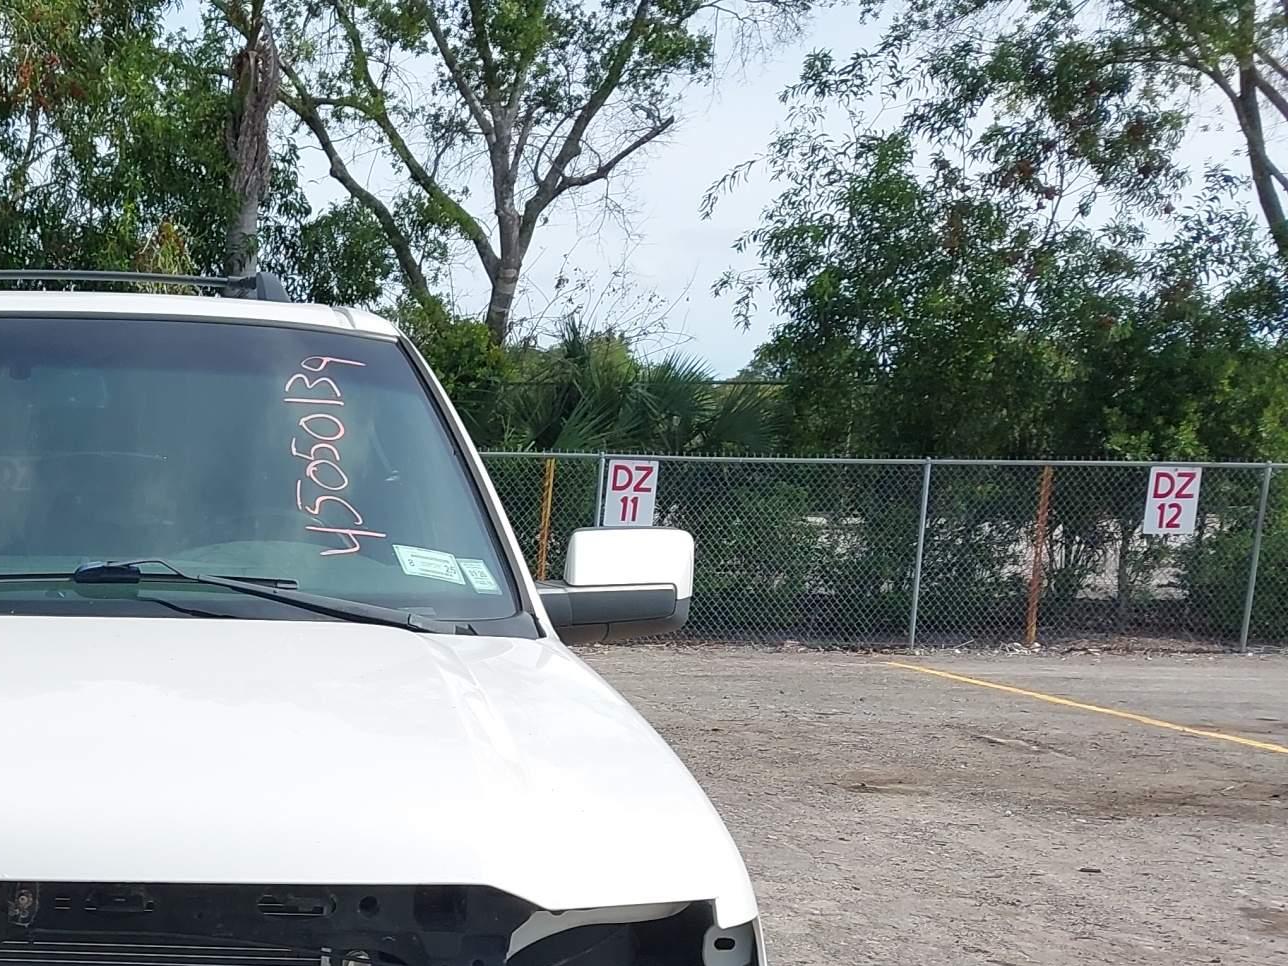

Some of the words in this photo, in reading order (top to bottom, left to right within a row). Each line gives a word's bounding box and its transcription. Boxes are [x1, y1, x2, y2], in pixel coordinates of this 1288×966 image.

[283, 356, 387, 556] 45050139
[612, 464, 654, 493] DZ
[1152, 471, 1197, 499] DZ
[620, 495, 639, 522] 11
[1156, 502, 1182, 529] 12
